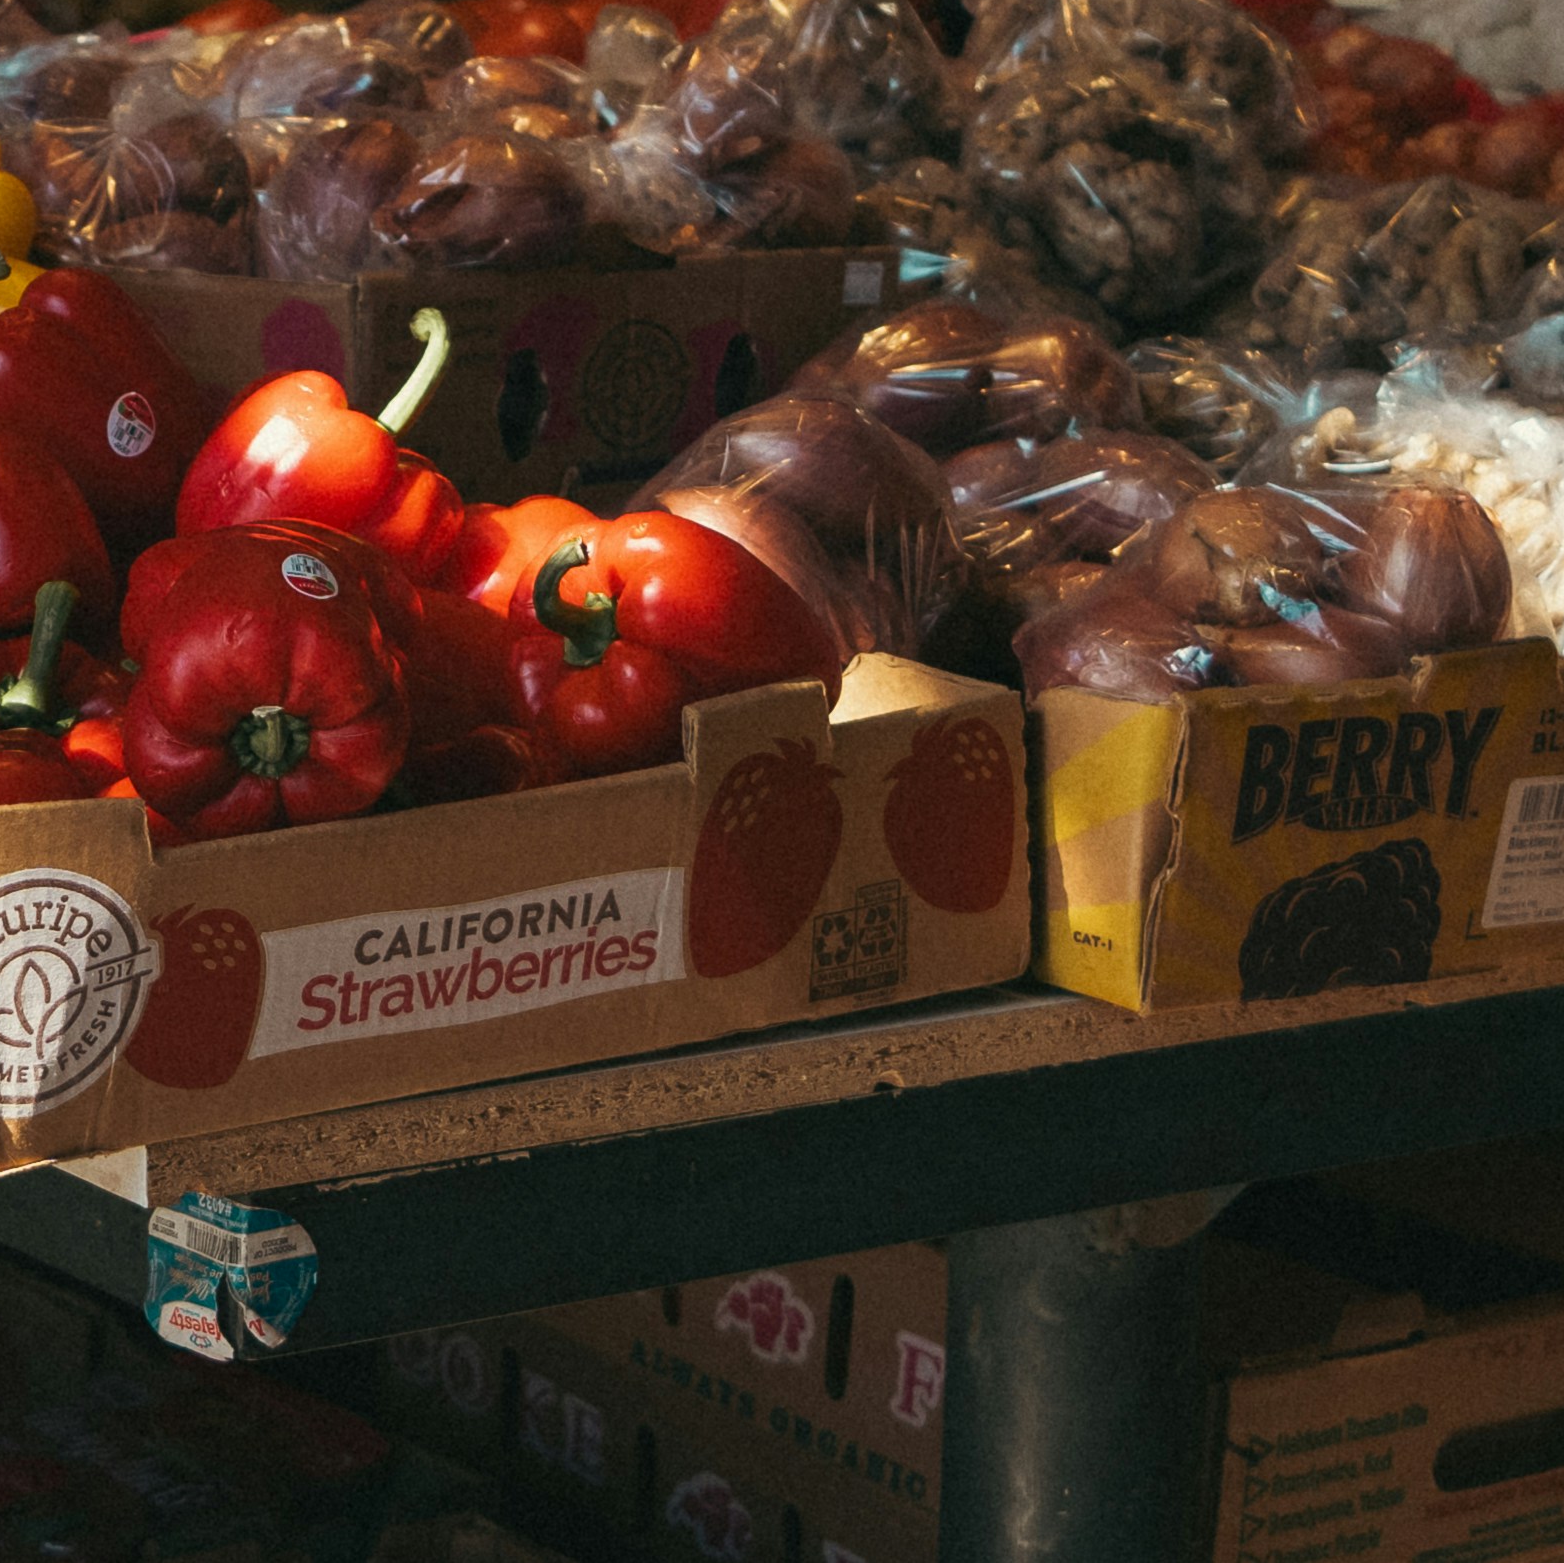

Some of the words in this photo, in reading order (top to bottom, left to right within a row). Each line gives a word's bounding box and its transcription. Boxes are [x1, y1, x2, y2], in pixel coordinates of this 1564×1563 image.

[1233, 705, 1504, 844] BERRY
[1319, 798, 1417, 829] VALLEY
[353, 887, 623, 967] CALIFORNIA
[95, 959, 137, 985] 1917
[297, 924, 659, 1033] Strawberries
[58, 999, 116, 1071] FRESH
[197, 1192, 233, 1215] #4032
[629, 1339, 756, 1418] ALWAYS
[769, 1404, 928, 1504] ORGANIC
